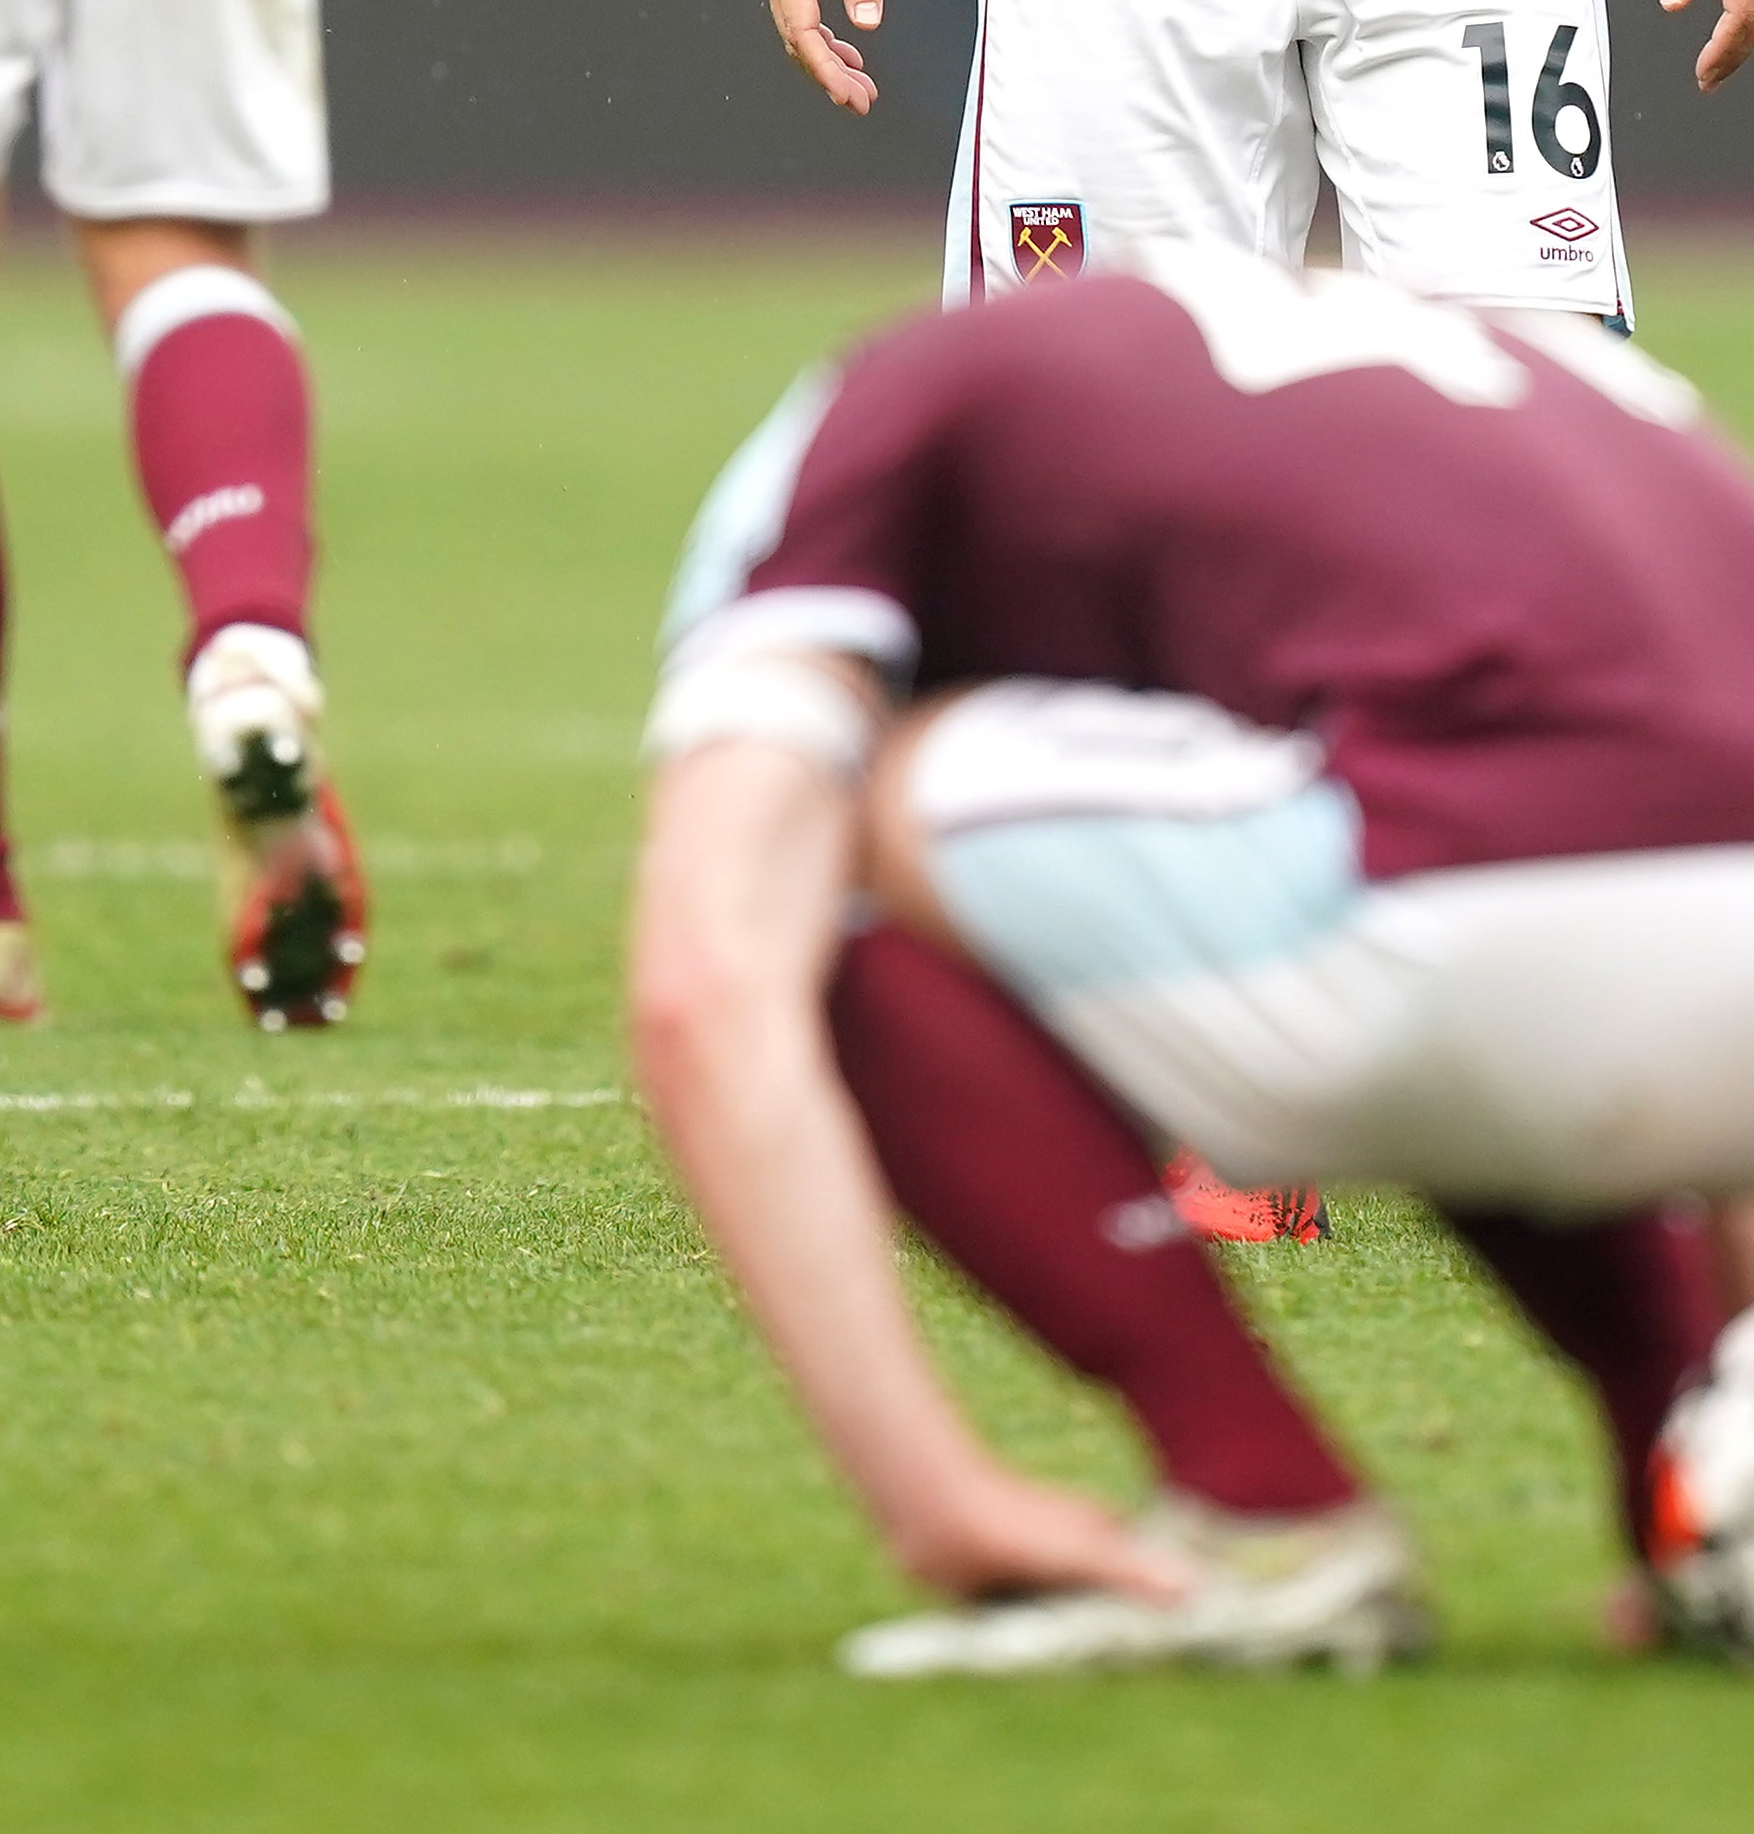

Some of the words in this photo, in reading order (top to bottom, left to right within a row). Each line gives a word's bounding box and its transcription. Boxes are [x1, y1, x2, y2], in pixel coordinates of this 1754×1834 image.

[1461, 21, 1602, 180] 16
[1012, 207, 1041, 218] WEST
[1041, 207, 1073, 219] HAM
[1540, 245, 1594, 263] umbro
